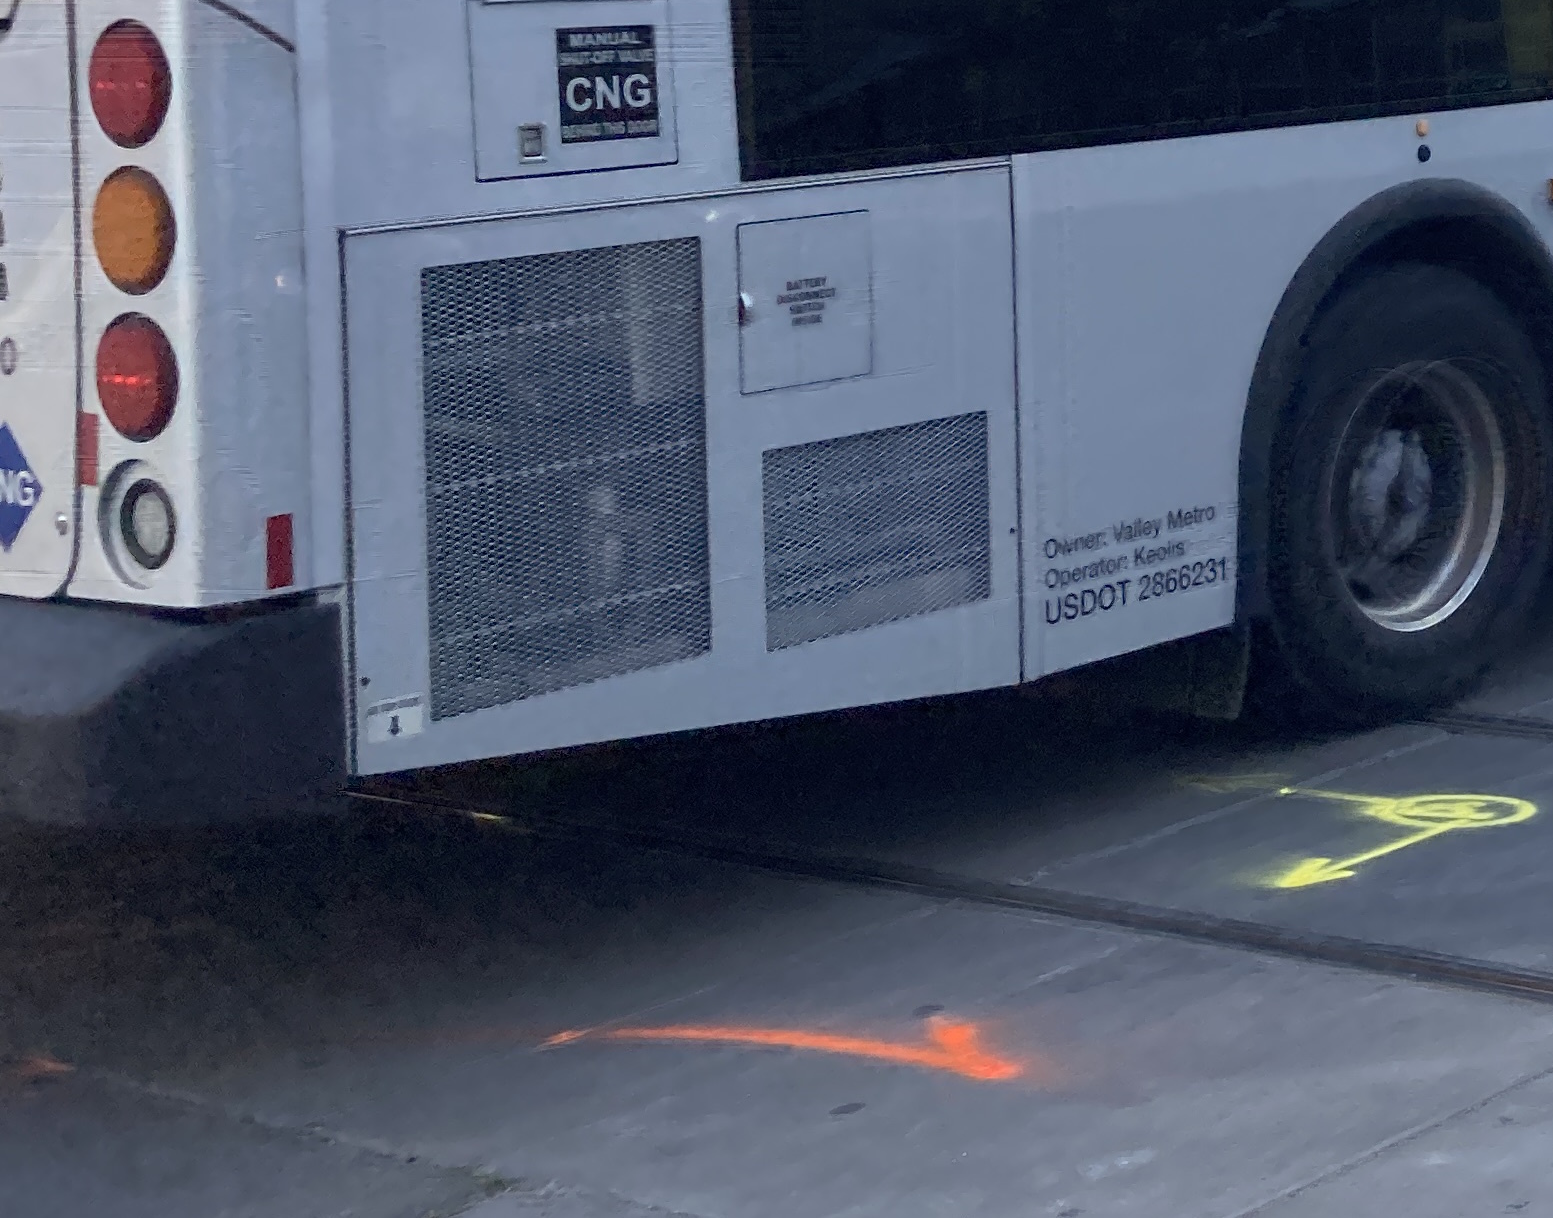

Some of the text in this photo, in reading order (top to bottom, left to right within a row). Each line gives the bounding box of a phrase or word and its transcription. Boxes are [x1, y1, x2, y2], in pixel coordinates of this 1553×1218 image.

[566, 73, 652, 112] CNG
[1044, 504, 1216, 559] Owner: Valley Metro
[1044, 539, 1186, 589] Operator: Keolis
[1045, 556, 1229, 624] USDOT 2866231
